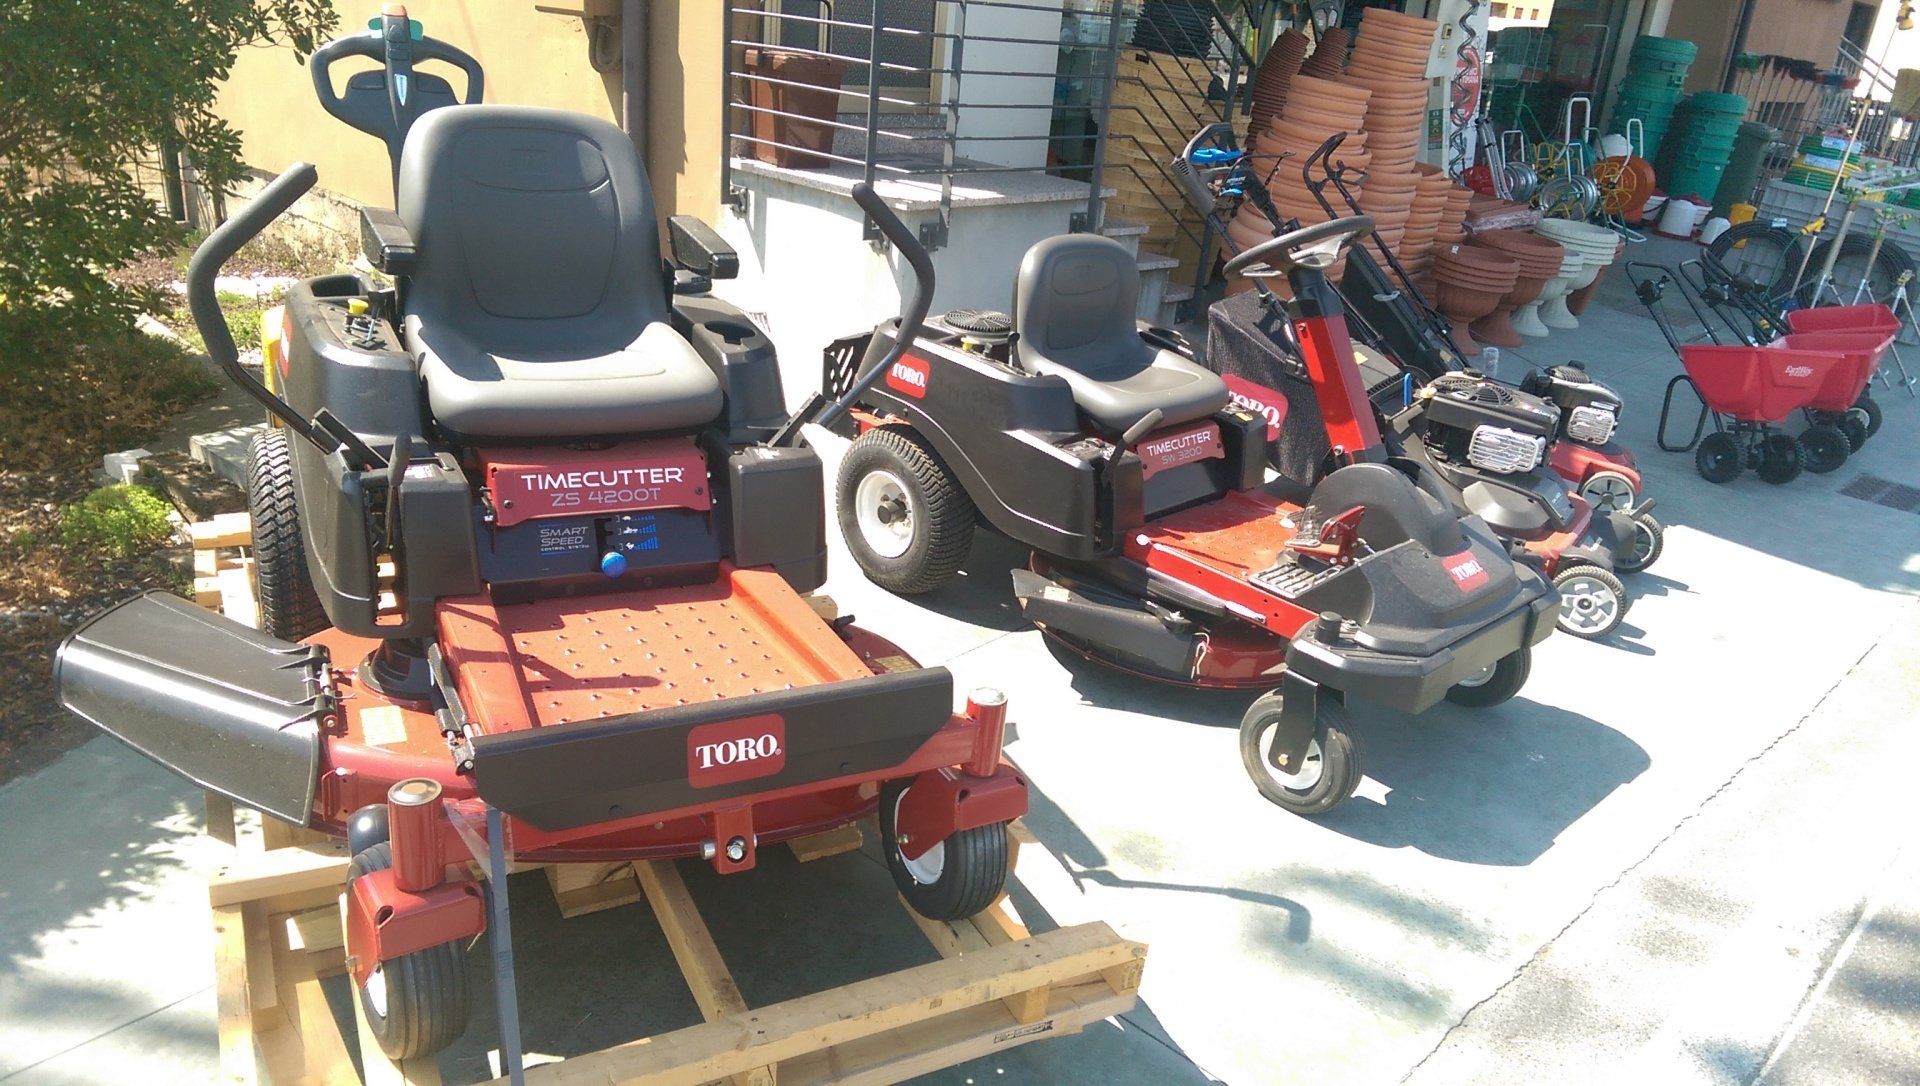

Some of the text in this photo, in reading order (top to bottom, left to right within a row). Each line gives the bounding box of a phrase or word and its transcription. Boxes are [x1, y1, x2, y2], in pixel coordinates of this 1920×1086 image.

[892, 363, 925, 387] TORO
[1147, 431, 1211, 456] TIMECUTTER
[1178, 446, 1202, 460] 3200
[521, 468, 683, 490] TIMECUTTER
[551, 488, 661, 507] ZS 4200T
[540, 526, 588, 538] SMART
[541, 536, 583, 547] SPEED
[1451, 560, 1481, 580] TORO
[696, 734, 777, 768] TORO
